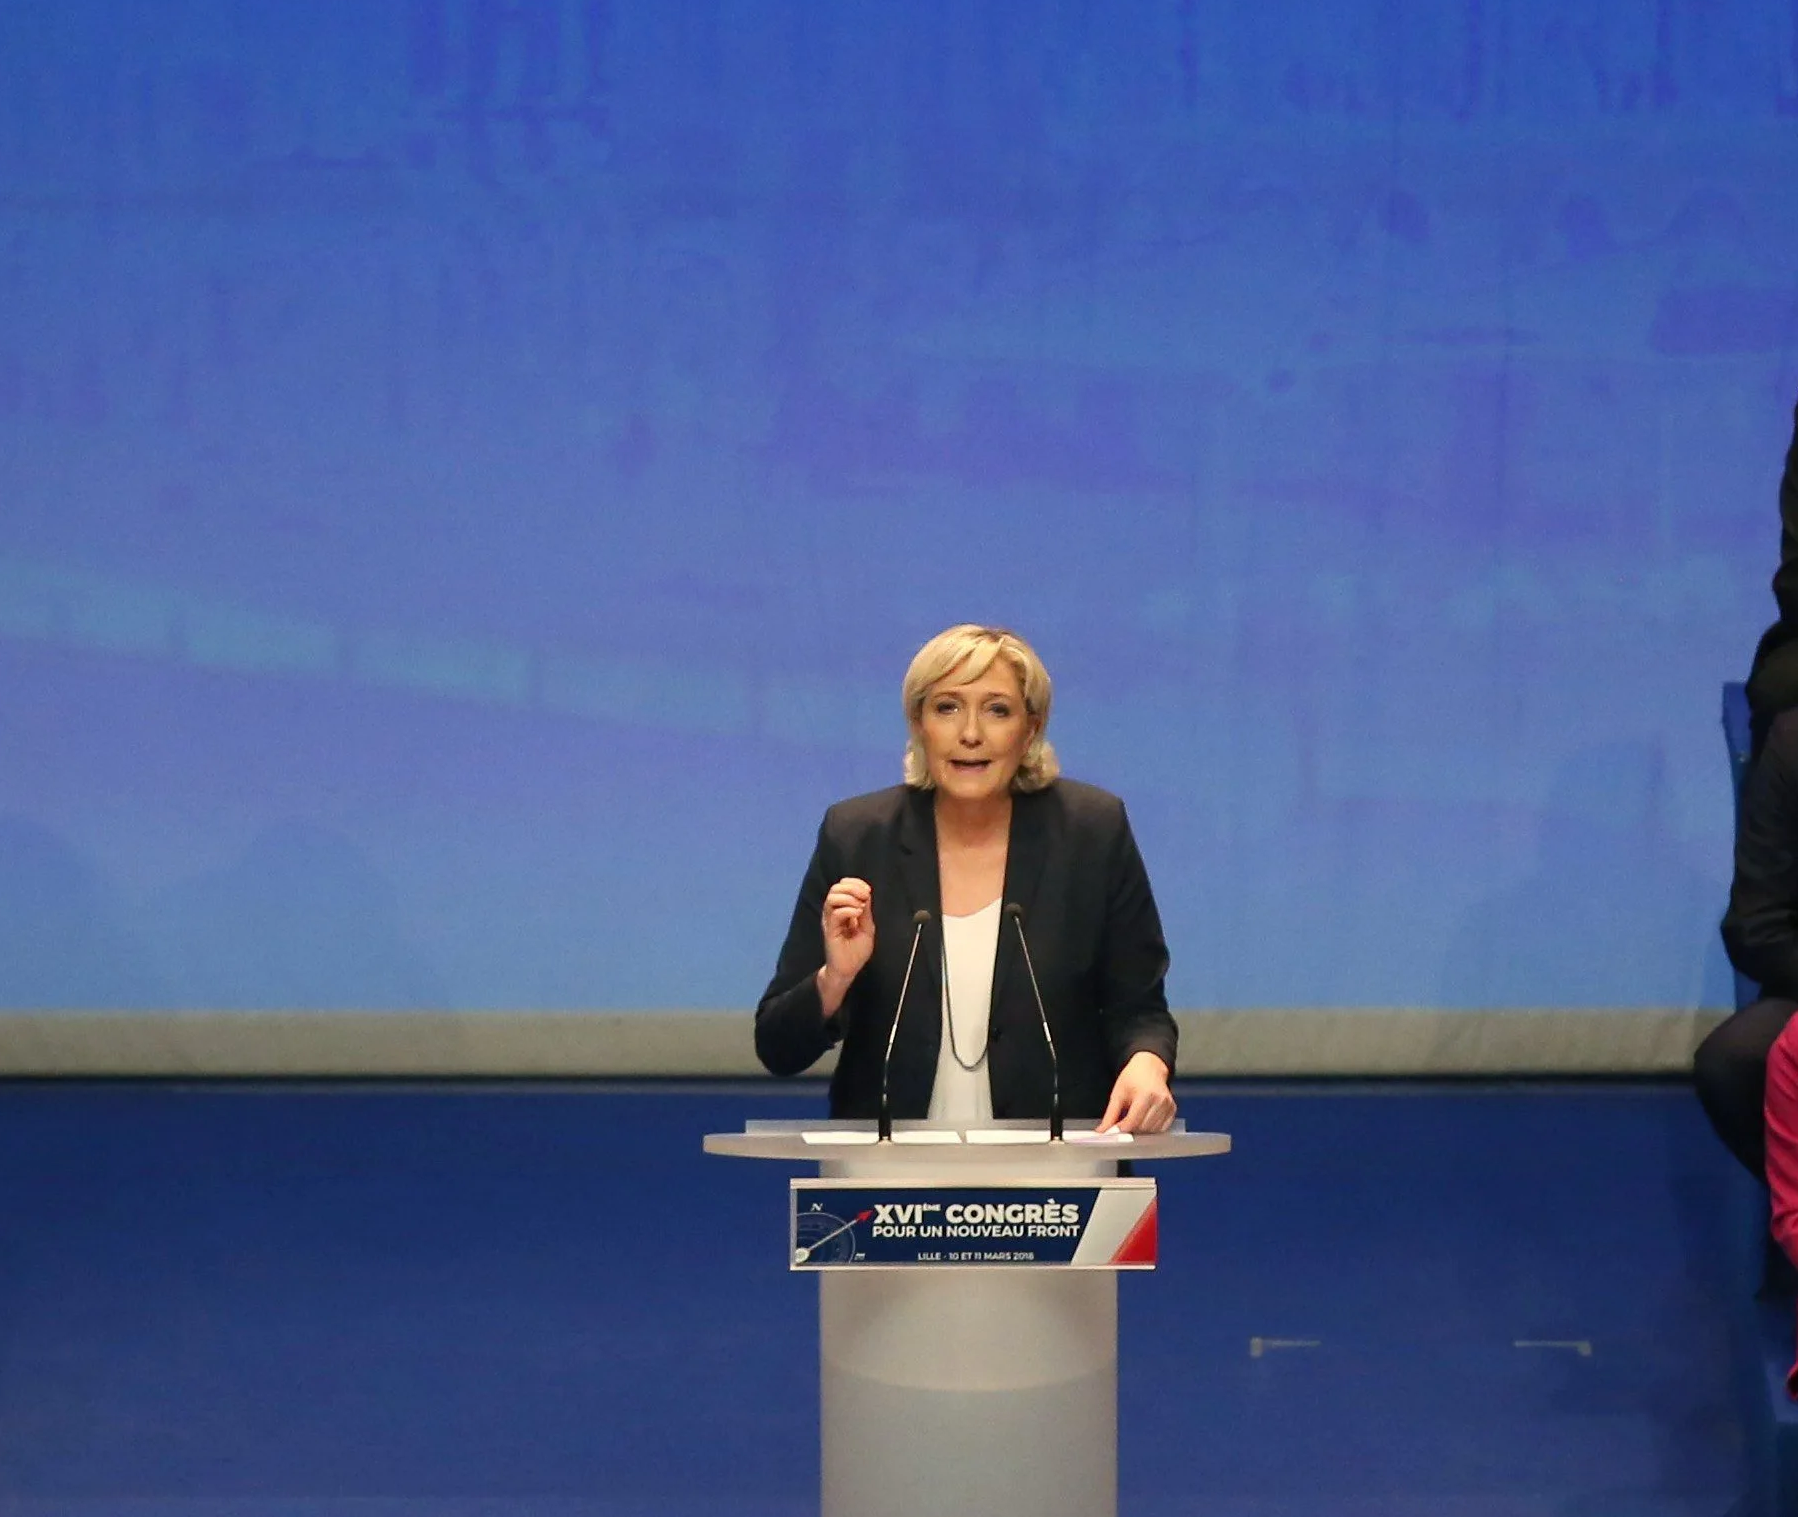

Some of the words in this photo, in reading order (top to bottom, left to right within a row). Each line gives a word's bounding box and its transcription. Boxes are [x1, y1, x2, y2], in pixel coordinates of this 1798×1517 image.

[811, 1202, 824, 1211] N
[945, 1198, 1080, 1224] CONGRÈS
[872, 1225, 916, 1238] POUR
[919, 1225, 943, 1238] UN
[946, 1225, 1024, 1238] NOUVEAU
[1027, 1225, 1080, 1237] FRONT
[917, 1252, 941, 1261] LILLE
[948, 1252, 959, 1261] 10
[960, 1252, 972, 1261] ET
[974, 1252, 982, 1260] 11
[984, 1251, 1011, 1261] MARS
